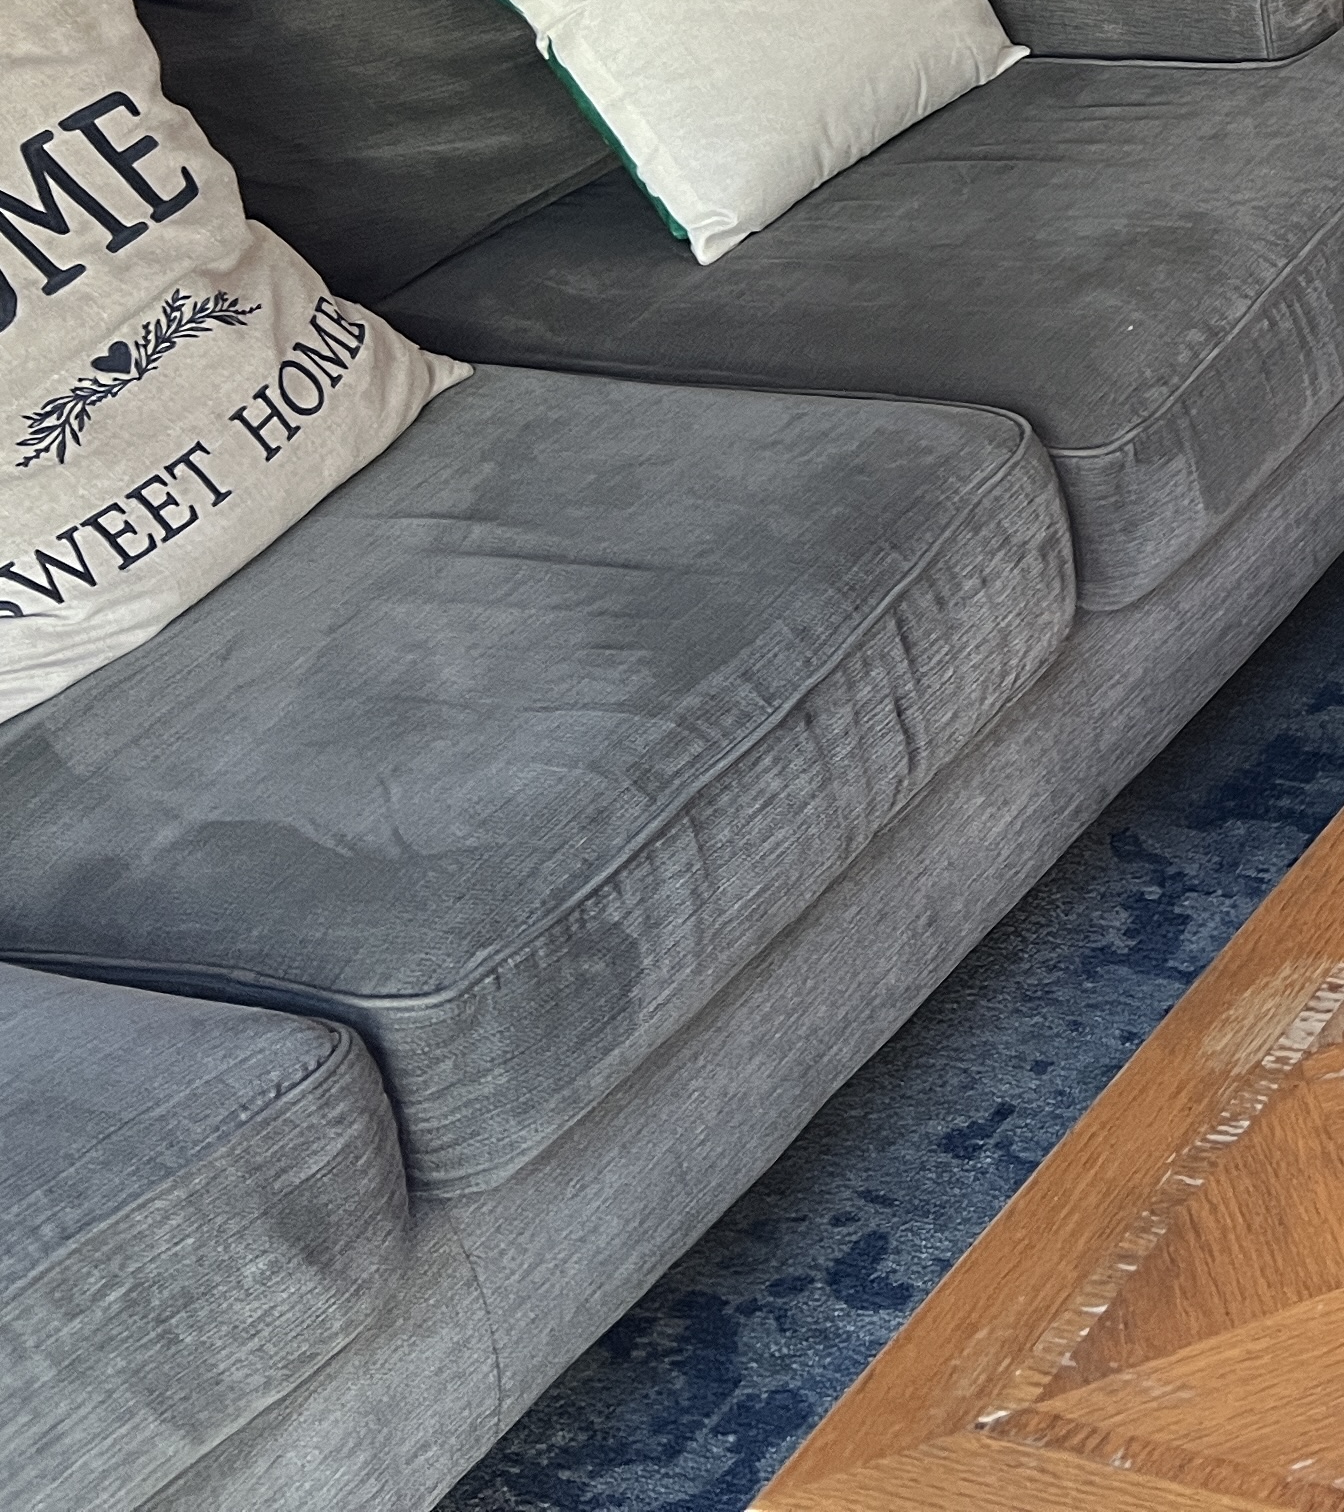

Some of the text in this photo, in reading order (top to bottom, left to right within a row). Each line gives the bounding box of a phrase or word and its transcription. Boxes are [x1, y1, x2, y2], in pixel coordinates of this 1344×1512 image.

[0, 91, 199, 332] ME
[0, 296, 366, 618] WEET HOME
